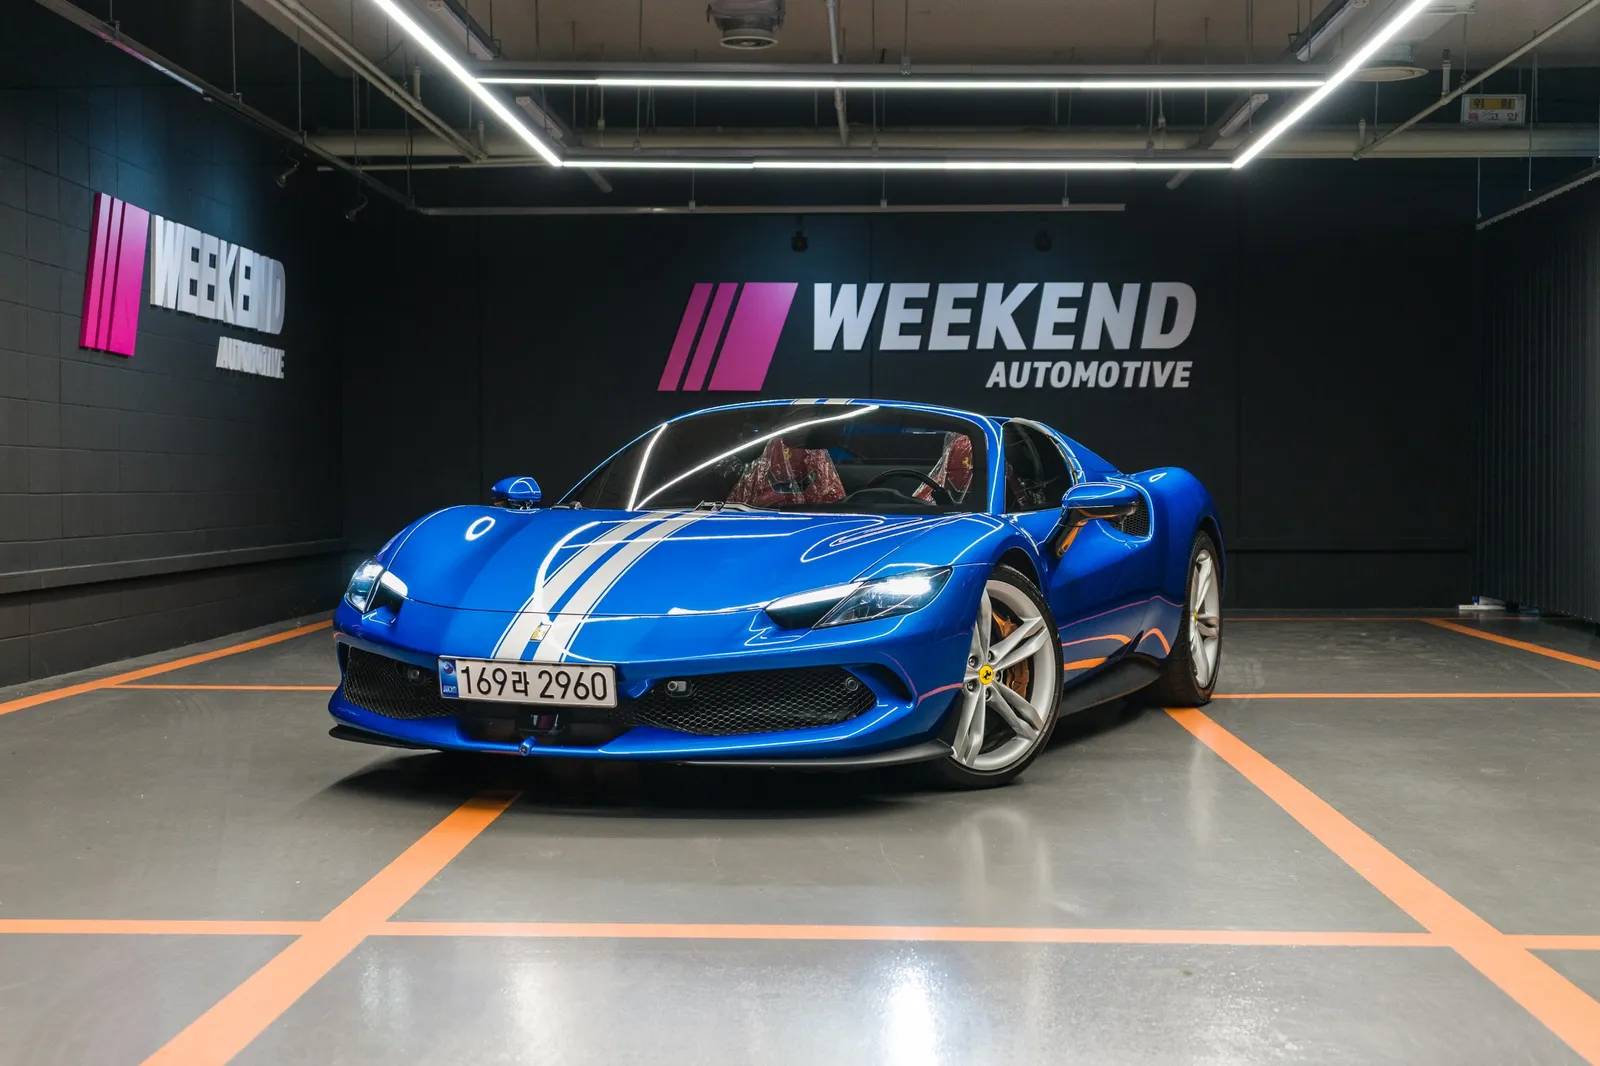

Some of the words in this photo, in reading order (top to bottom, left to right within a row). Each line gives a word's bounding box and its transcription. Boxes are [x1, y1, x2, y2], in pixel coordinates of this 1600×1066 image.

[150, 214, 286, 335] WEEKEND
[813, 282, 1197, 350] WEEKEND
[986, 360, 1192, 389] AUTOMOTIVE
[461, 666, 530, 697] 169라
[538, 669, 608, 701] 2960
